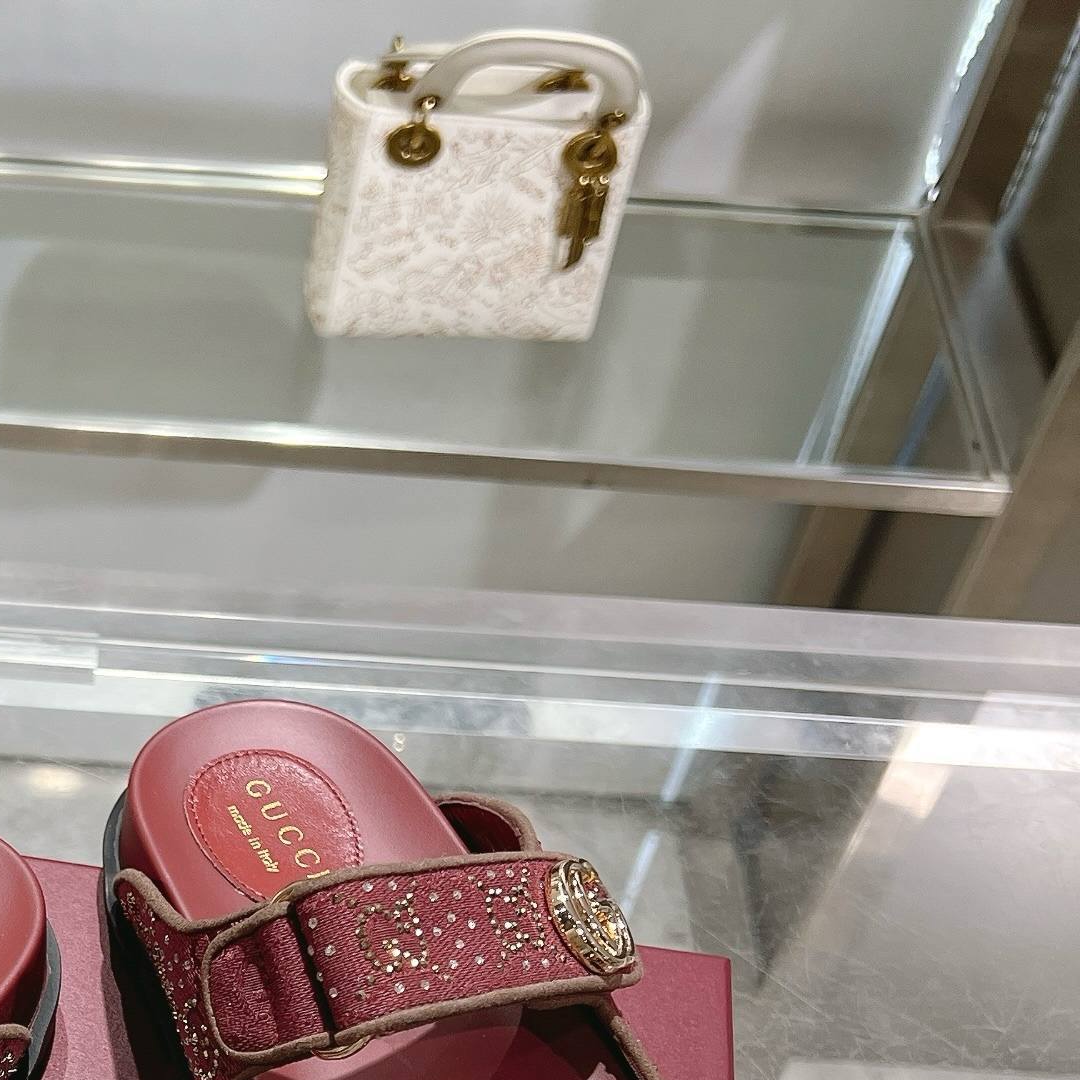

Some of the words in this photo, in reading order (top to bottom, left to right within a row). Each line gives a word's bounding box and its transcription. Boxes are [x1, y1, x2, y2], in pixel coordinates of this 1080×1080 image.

[226, 804, 253, 837] made
[247, 836, 262, 850] in
[256, 848, 281, 874] Italy
[245, 779, 330, 879] GUCCI
